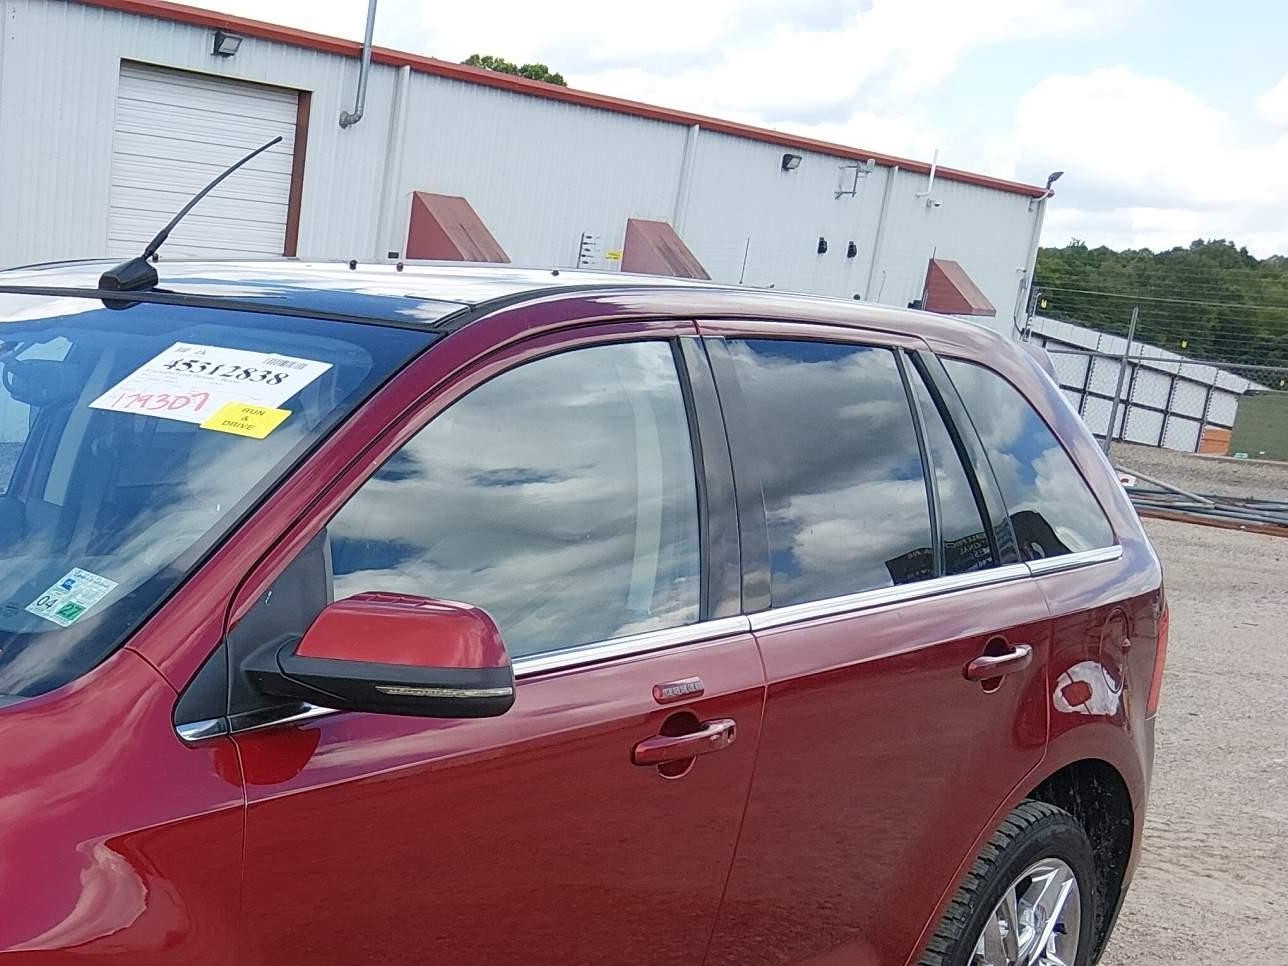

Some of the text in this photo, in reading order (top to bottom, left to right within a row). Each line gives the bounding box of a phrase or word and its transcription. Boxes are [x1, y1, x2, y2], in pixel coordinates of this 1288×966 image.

[241, 407, 266, 417] RUN
[221, 420, 255, 432] DRIVE
[36, 595, 59, 608] 04
[57, 603, 82, 618] 27
